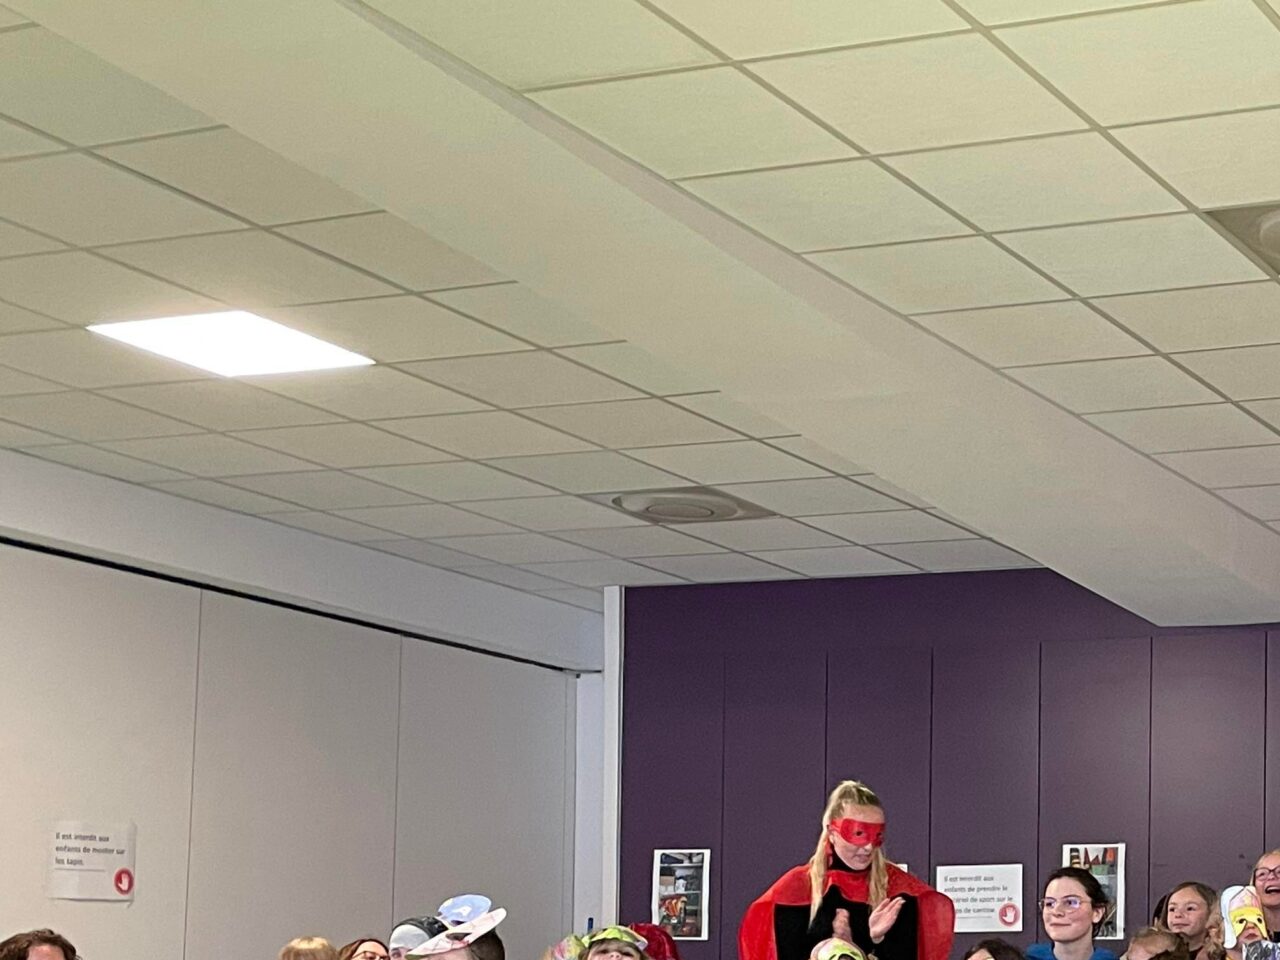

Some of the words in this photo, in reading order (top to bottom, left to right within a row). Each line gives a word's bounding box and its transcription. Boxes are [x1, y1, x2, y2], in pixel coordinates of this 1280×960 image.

[55, 845, 81, 853] enfants
[92, 847, 115, 855] monter
[976, 885, 1001, 893] prendre
[979, 896, 996, 904] sport
